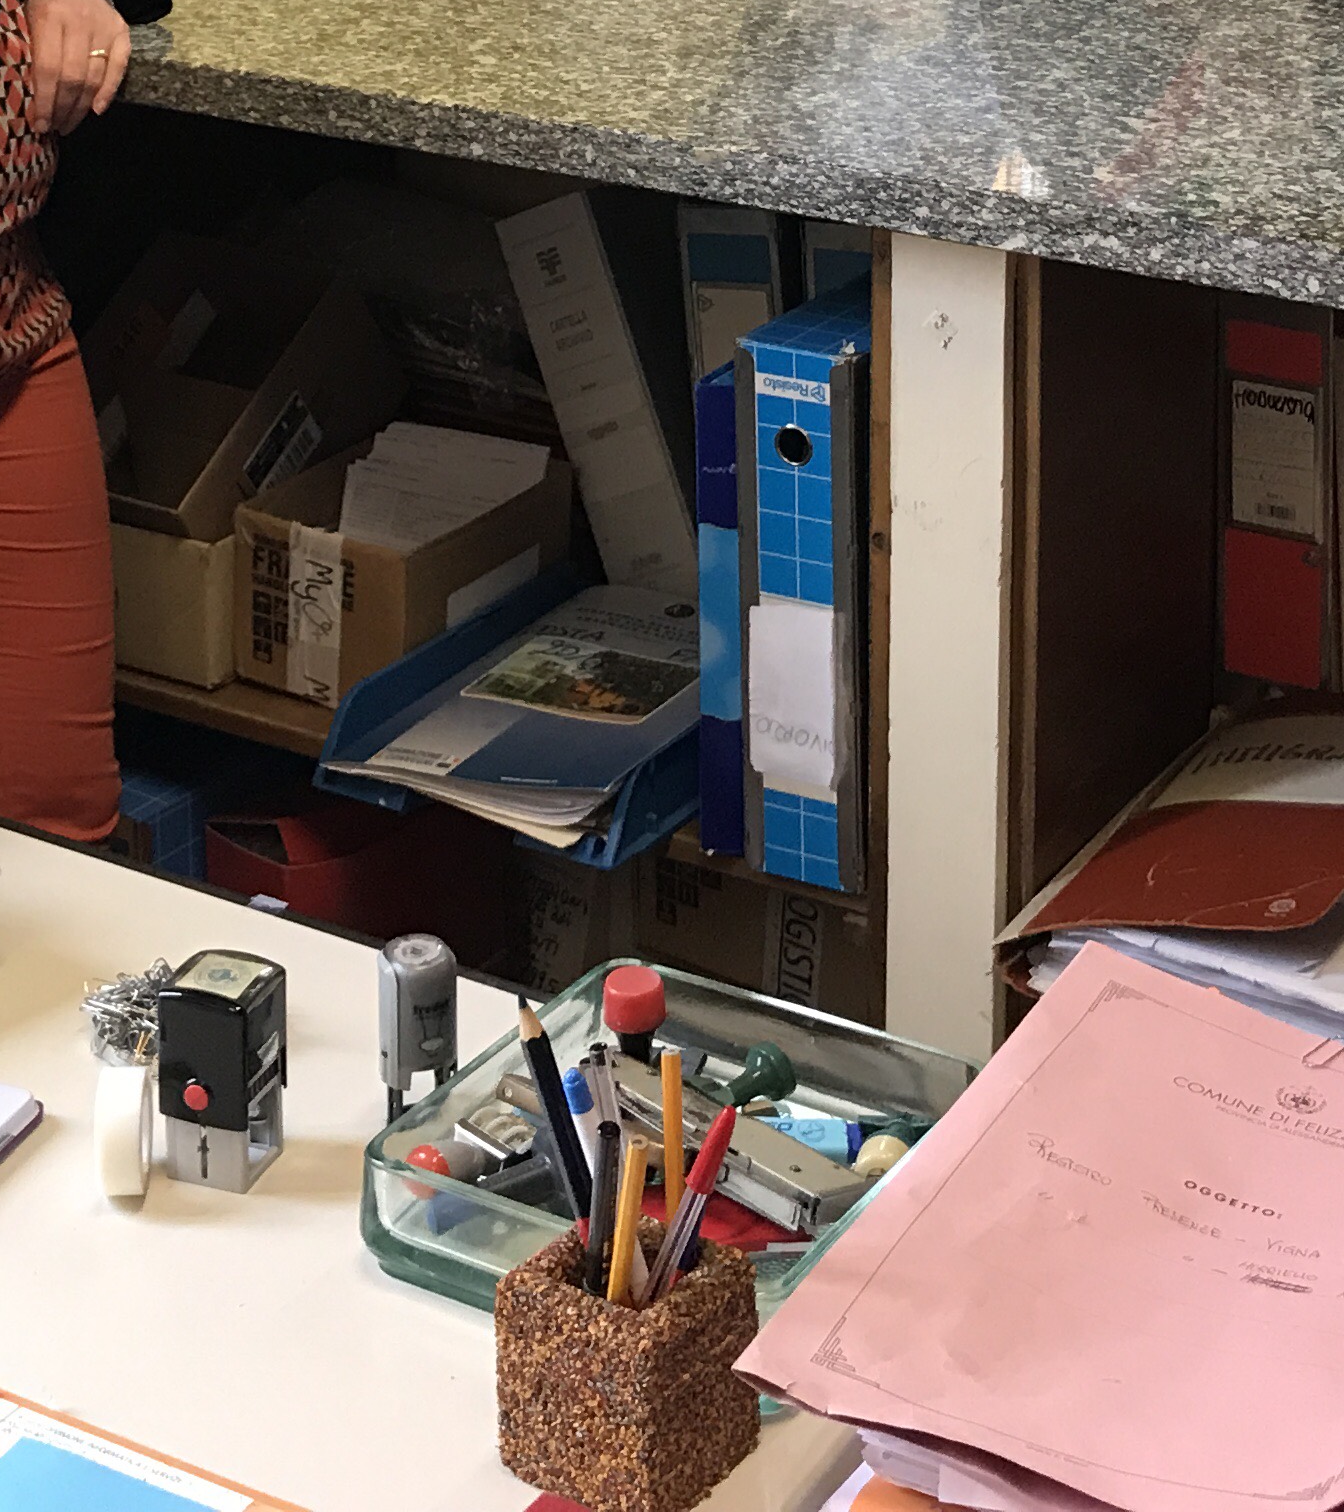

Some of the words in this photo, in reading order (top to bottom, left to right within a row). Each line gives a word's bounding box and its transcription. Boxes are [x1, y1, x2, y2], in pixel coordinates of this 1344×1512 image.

[1173, 1076, 1265, 1117] COMUNE
[1269, 1110, 1290, 1126] DI
[1216, 1104, 1267, 1128] PROVINCIA
[1269, 1123, 1281, 1131] DI
[1183, 1179, 1283, 1221] OGGETTO:
[1265, 1237, 1321, 1261] VIGNA
